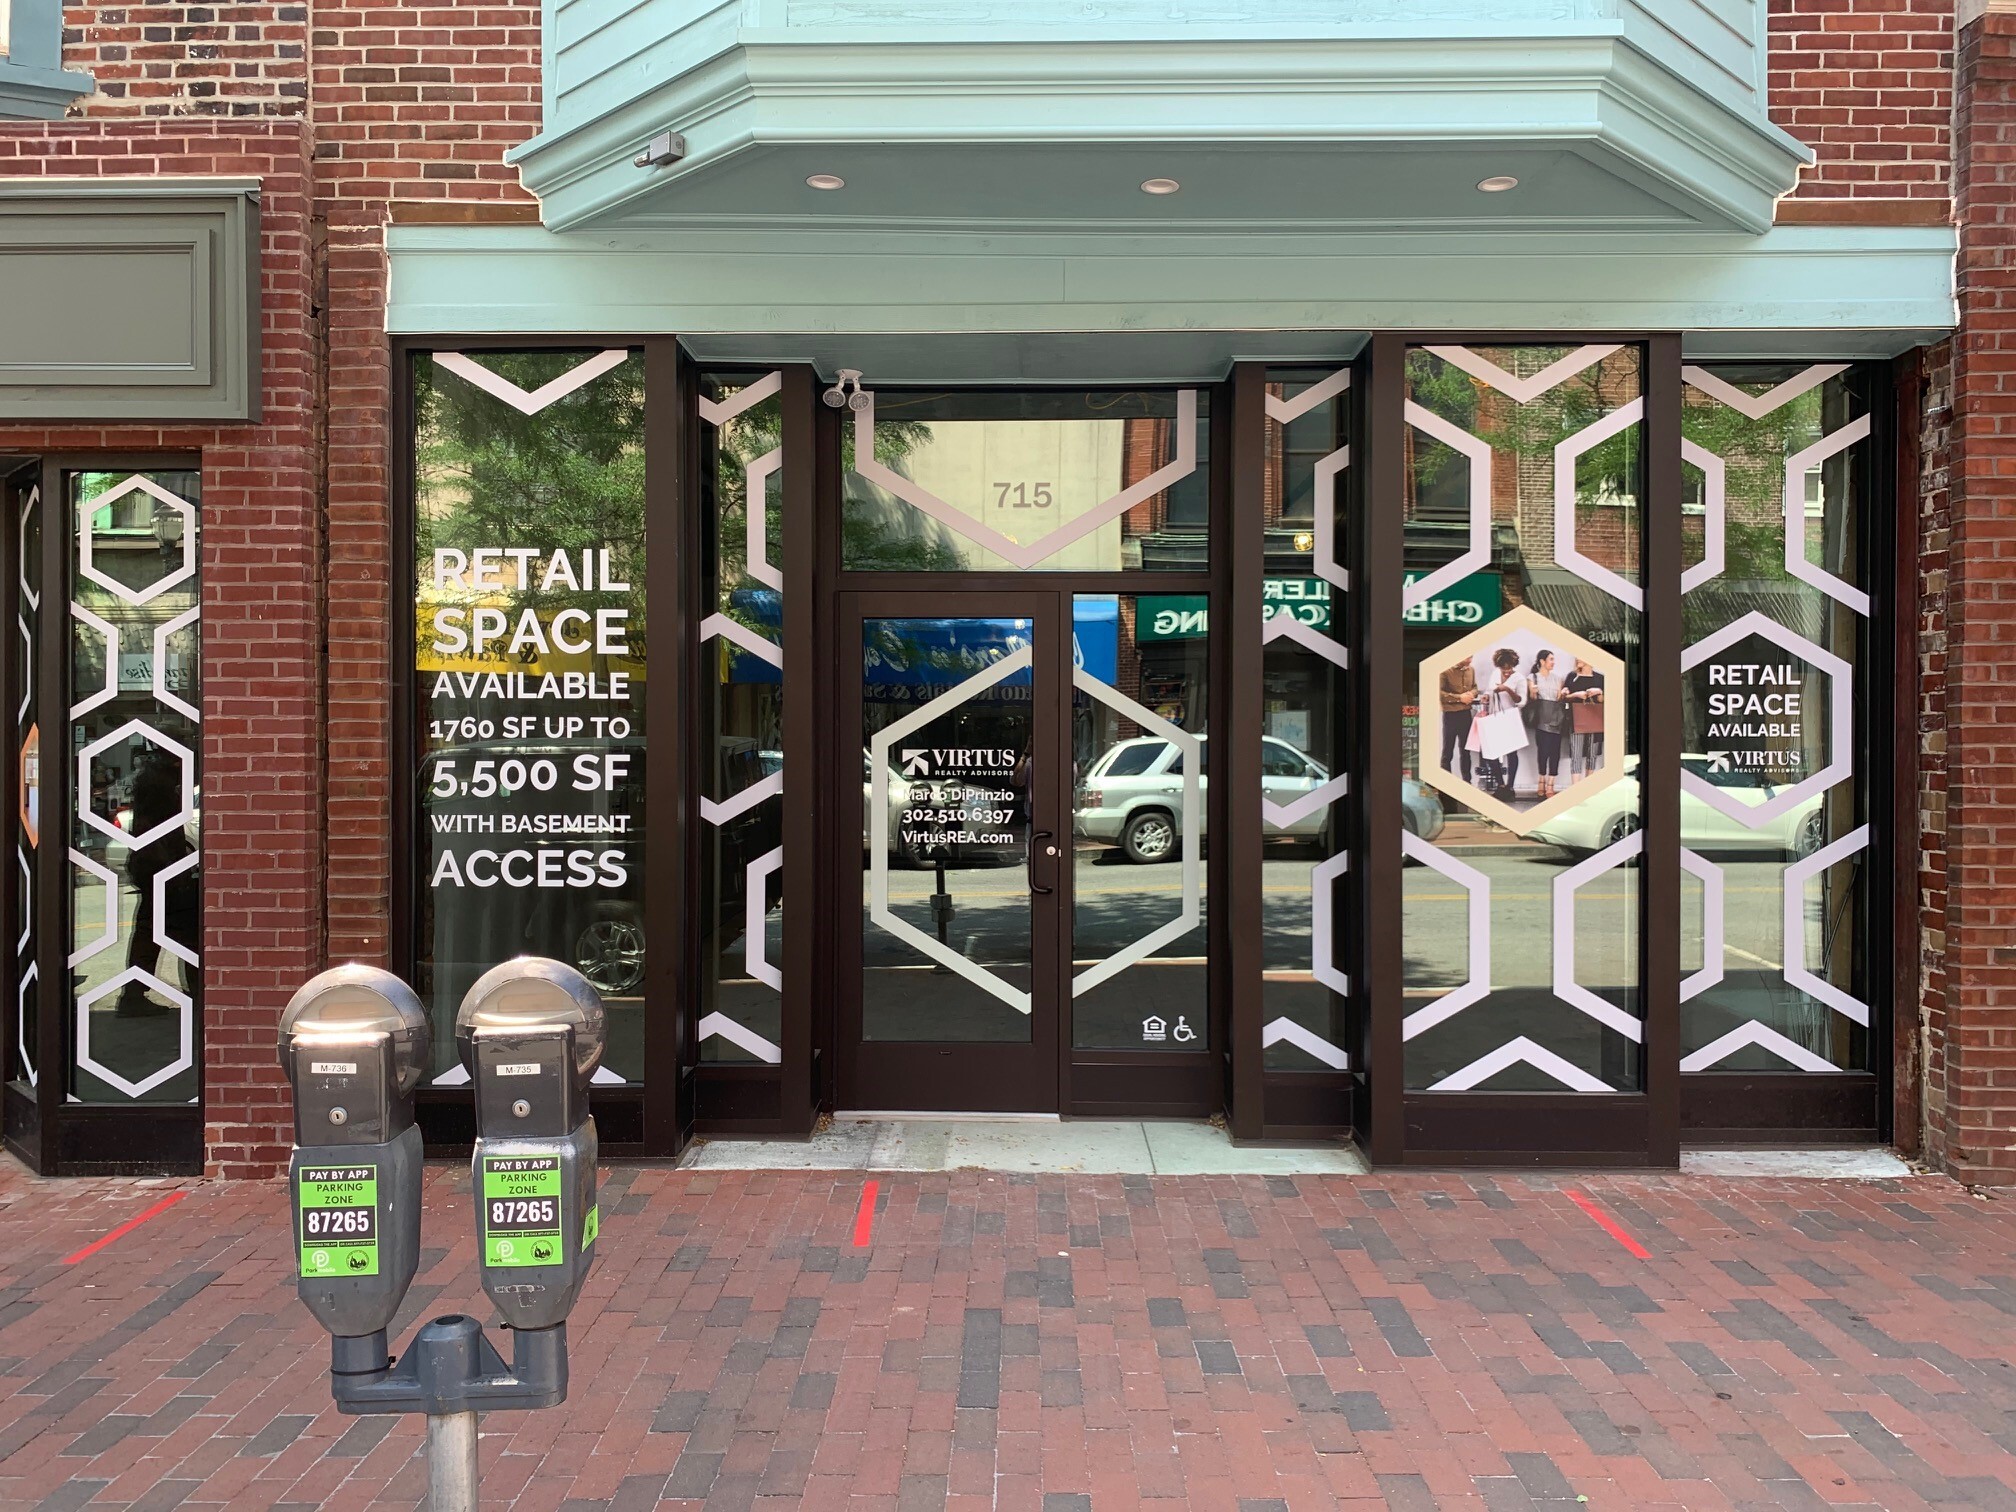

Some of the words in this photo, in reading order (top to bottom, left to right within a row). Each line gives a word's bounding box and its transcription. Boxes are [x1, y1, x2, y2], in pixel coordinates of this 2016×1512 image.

[993, 482, 1052, 508] 715
[434, 549, 630, 591] RETAIL
[433, 608, 629, 654] SPACE
[1709, 664, 1801, 686] RETAIL
[431, 672, 630, 699] AVAILABLE
[1708, 694, 1800, 716] SPACE
[430, 717, 495, 740] 1760
[502, 716, 536, 739] SF
[544, 717, 584, 739] UP
[590, 716, 630, 739] TO
[1707, 723, 1801, 737] AVAILABLE
[932, 748, 1015, 767] VIRTUS
[1731, 750, 1801, 766] VIRTUS
[432, 759, 558, 798] 5,500
[572, 754, 630, 791] SF
[904, 789, 947, 801] Marco
[952, 788, 1015, 801] DiPrinzio
[431, 814, 494, 833] WITH
[501, 814, 630, 833] BASEMENT
[902, 807, 1015, 824] 302.510.6397
[902, 830, 1014, 844] VirtusREA.com
[431, 849, 628, 888] ACCESS
[320, 1064, 347, 1073] M-736
[505, 1065, 532, 1074] M-735
[494, 1162, 512, 1170] PAY
[515, 1161, 528, 1170] BY
[532, 1160, 552, 1169] APP
[310, 1171, 328, 1180] PAY
[331, 1171, 344, 1179] BY
[348, 1170, 368, 1179] APP
[501, 1173, 547, 1182] PARKING
[317, 1183, 363, 1192] PARKING
[509, 1186, 537, 1194] ZONE
[325, 1196, 353, 1204] ZONE
[492, 1201, 553, 1223] 87265
[308, 1211, 369, 1233] 87265
